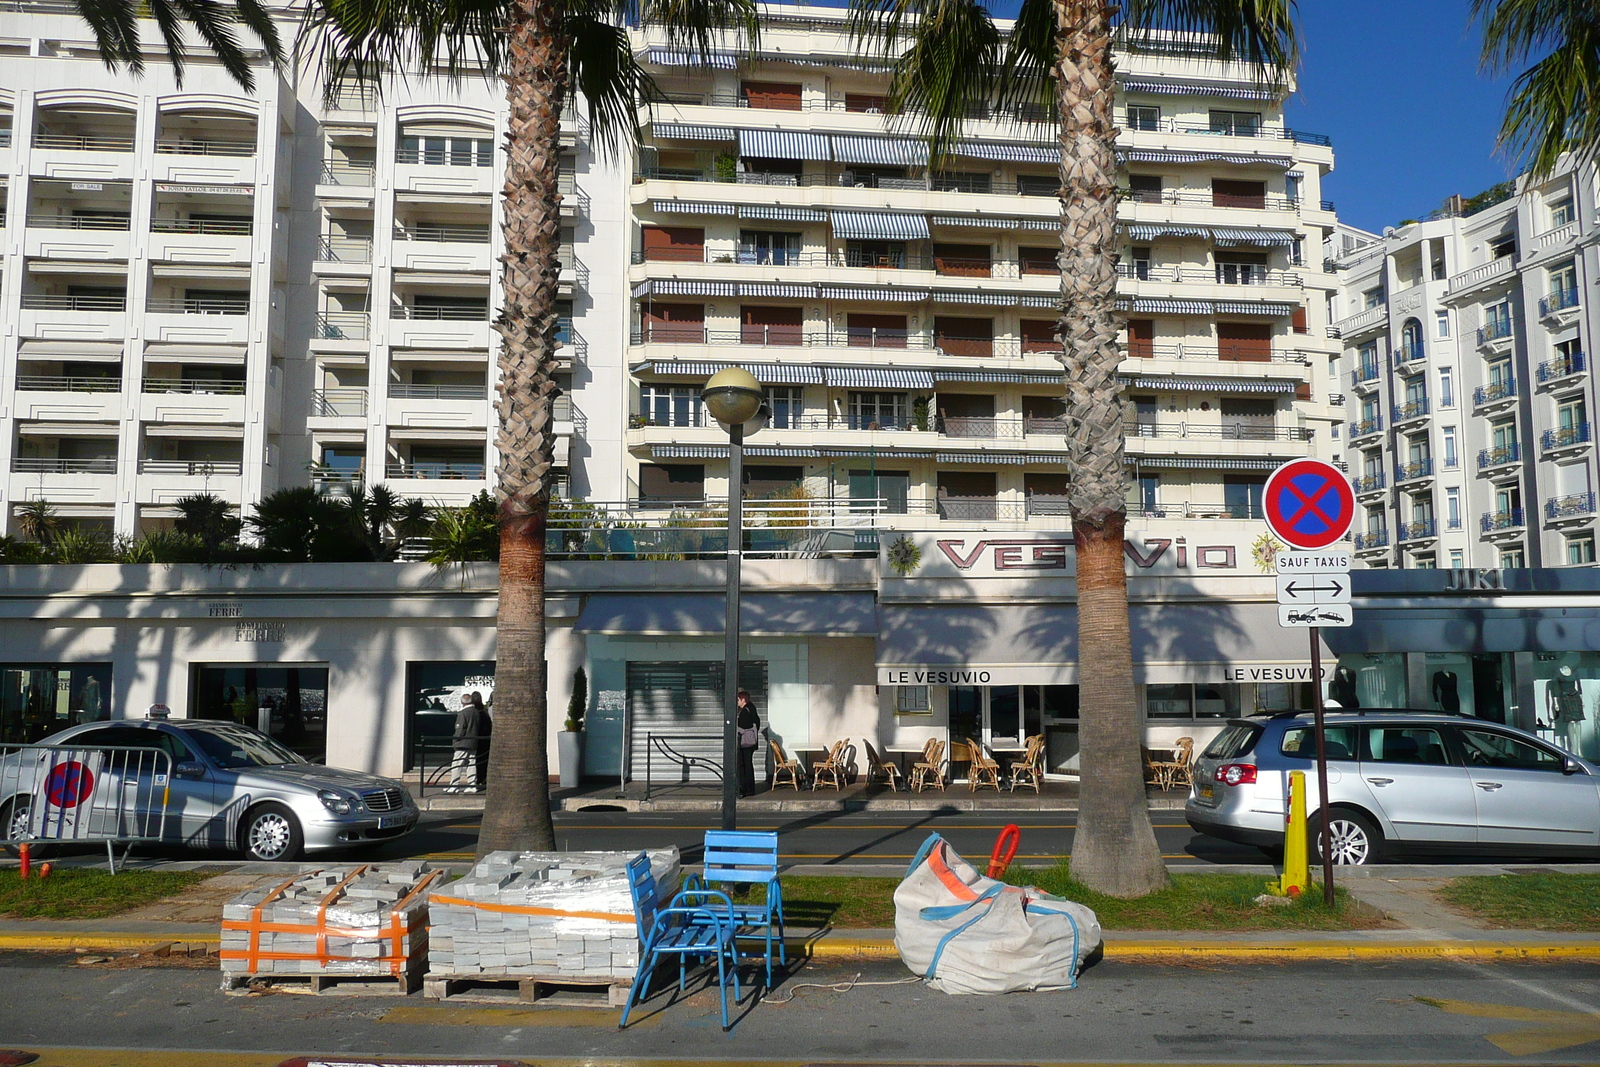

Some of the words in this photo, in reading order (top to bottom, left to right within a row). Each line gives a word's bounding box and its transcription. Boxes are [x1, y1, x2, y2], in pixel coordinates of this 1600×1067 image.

[1280, 557, 1310, 567] SAUF
[1314, 557, 1347, 567] TAXIS
[209, 608, 243, 617] FERRE
[235, 629, 286, 642] FERRE
[888, 671, 909, 683] LE
[914, 671, 991, 683] VESUVIO
[1224, 668, 1245, 681] LE
